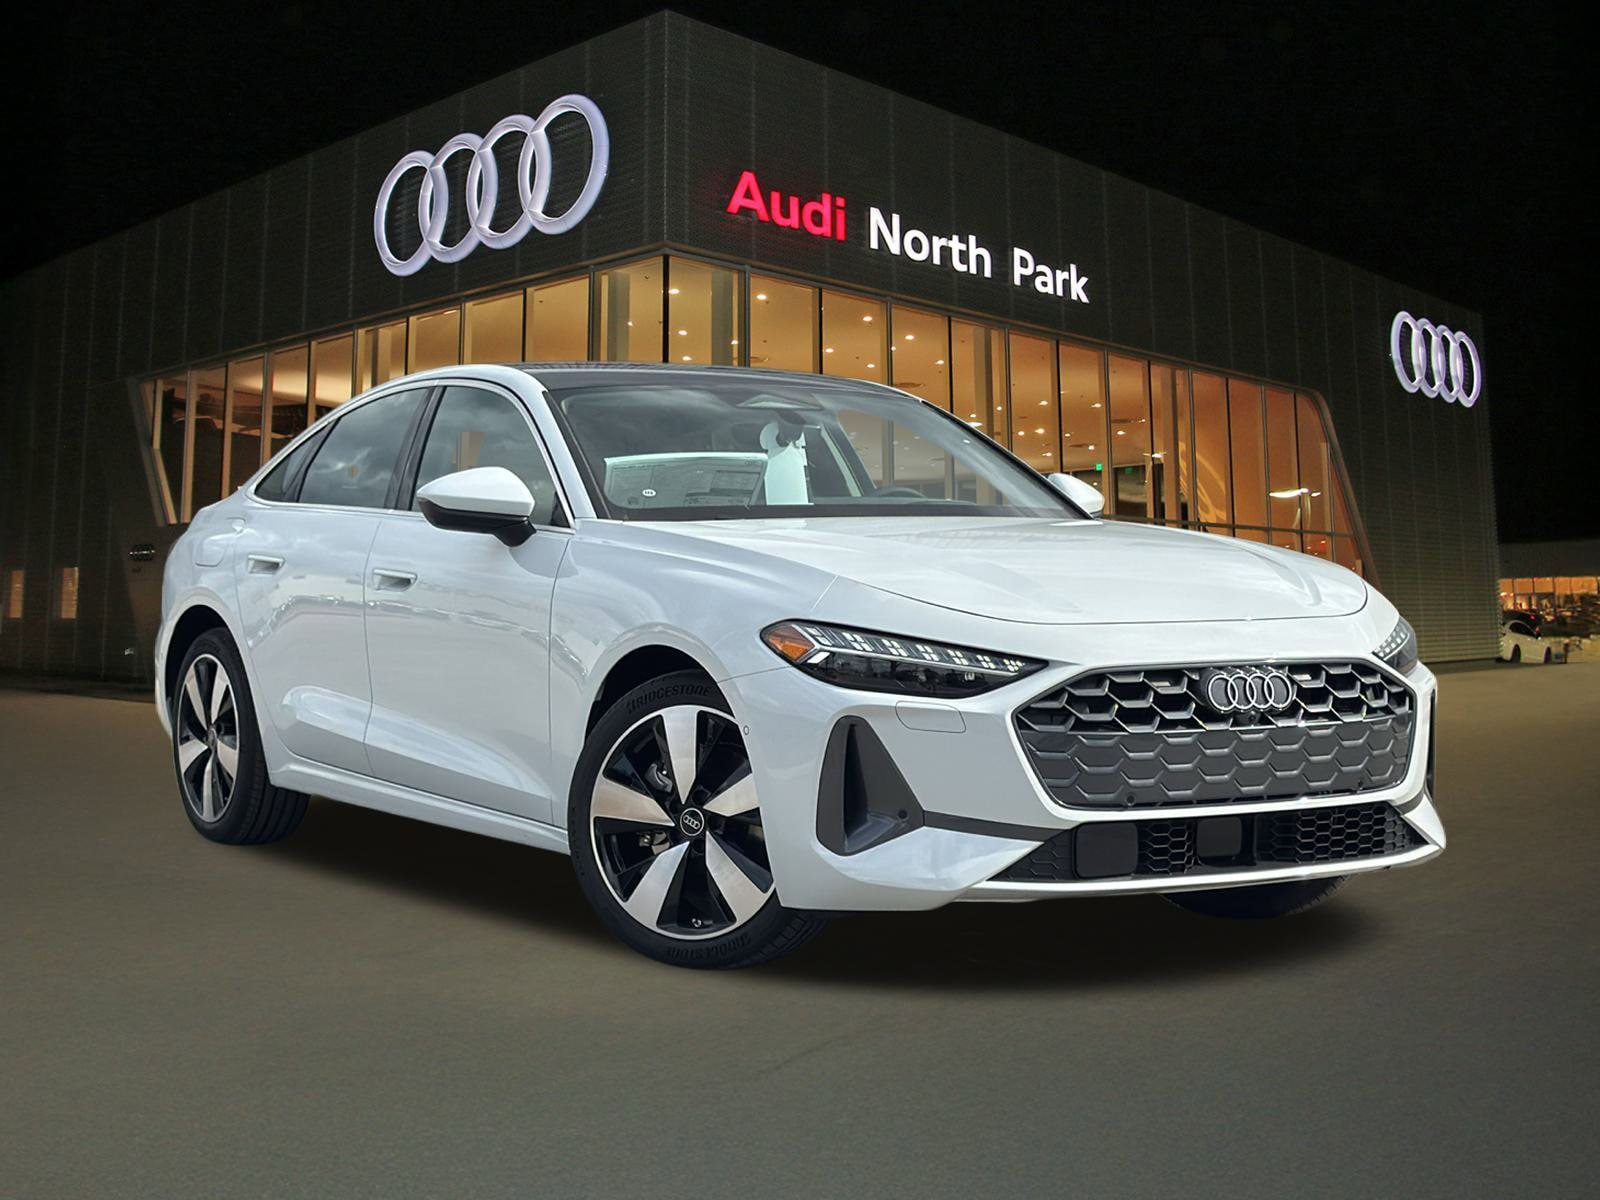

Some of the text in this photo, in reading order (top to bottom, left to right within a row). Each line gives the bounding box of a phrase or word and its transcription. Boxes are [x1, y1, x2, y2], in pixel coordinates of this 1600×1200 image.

[726, 170, 1091, 304] Audi North Park
[626, 684, 712, 715] BRIDGESTONE
